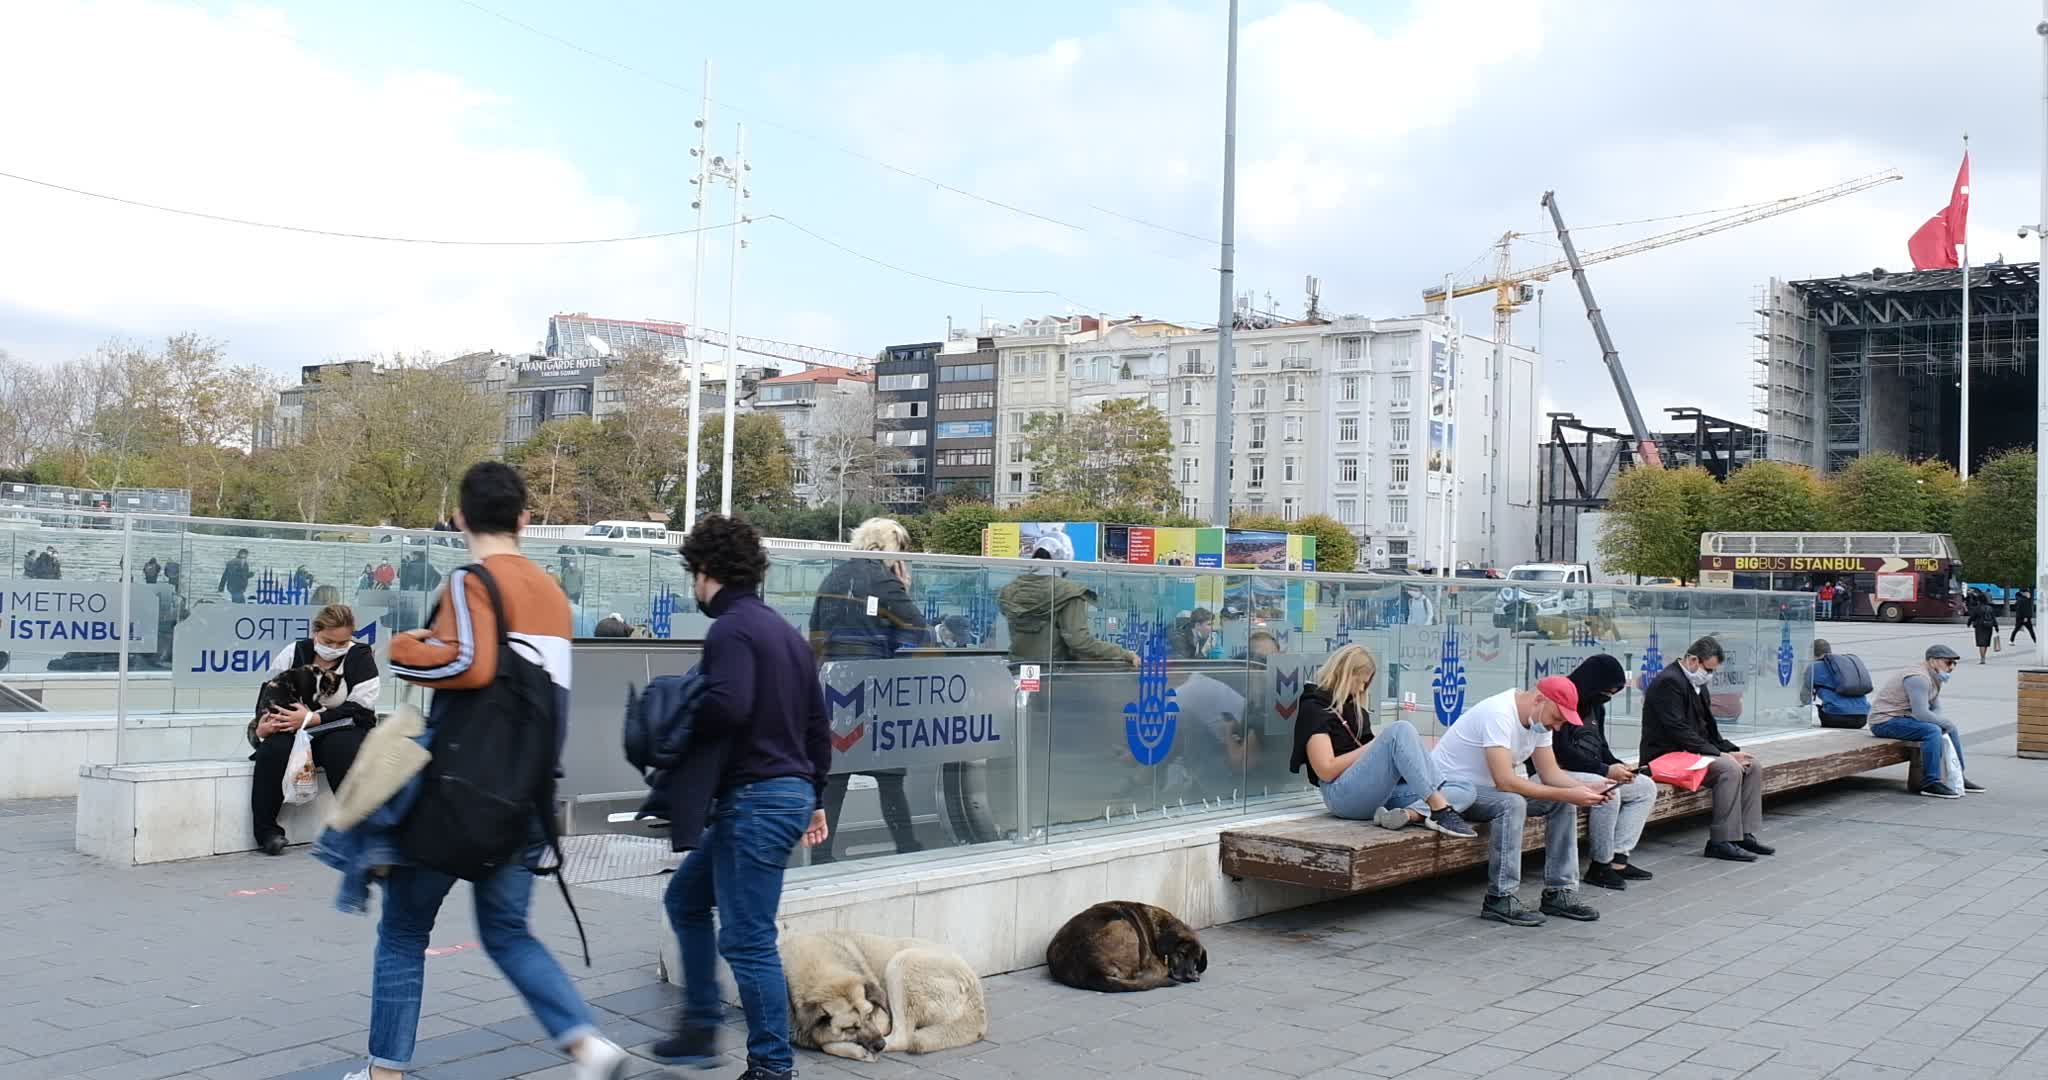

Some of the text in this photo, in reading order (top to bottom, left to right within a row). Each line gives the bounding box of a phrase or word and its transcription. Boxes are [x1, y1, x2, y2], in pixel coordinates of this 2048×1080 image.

[520, 359, 602, 372] AVANTGARDE HOTEL
[1790, 557, 1865, 571] ISTANBUL
[11, 591, 106, 613] METRO
[872, 674, 967, 708] METRO
[871, 713, 1001, 752] İSTANBUL
